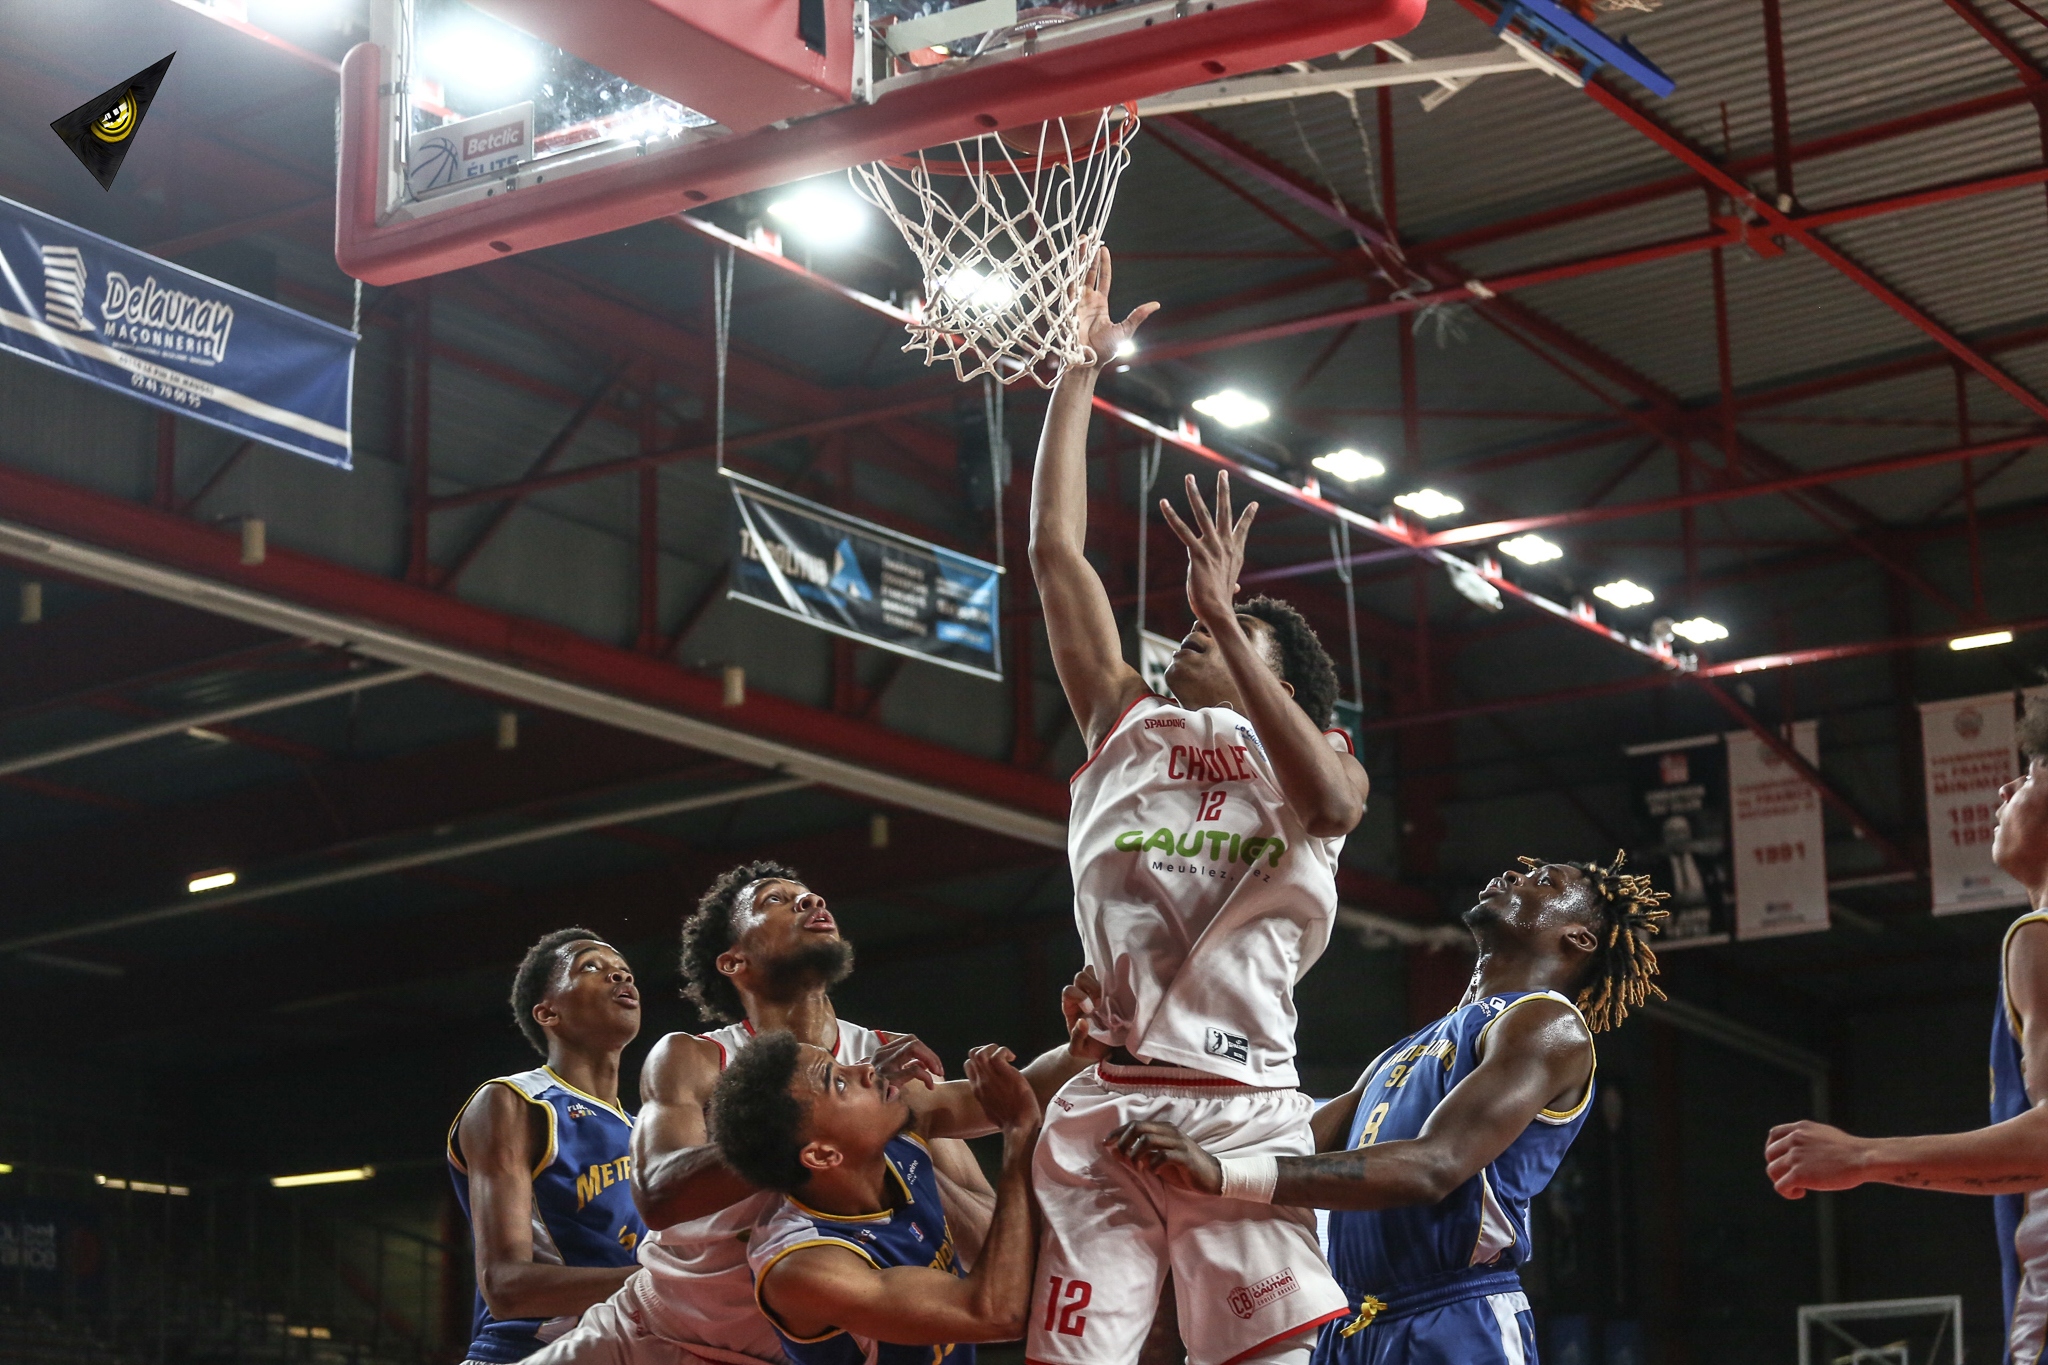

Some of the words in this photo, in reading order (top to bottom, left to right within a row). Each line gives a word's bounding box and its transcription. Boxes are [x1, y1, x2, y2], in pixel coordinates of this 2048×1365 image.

[467, 128, 519, 155] Betclic
[101, 271, 234, 363] Delaunay
[1144, 718, 1186, 730] SPALDING
[1195, 790, 1227, 823] 12
[1114, 827, 1286, 868] GAUTIER
[1356, 1102, 1390, 1150] 8
[1044, 1275, 1093, 1338] 12
[1232, 1292, 1253, 1315] CB
